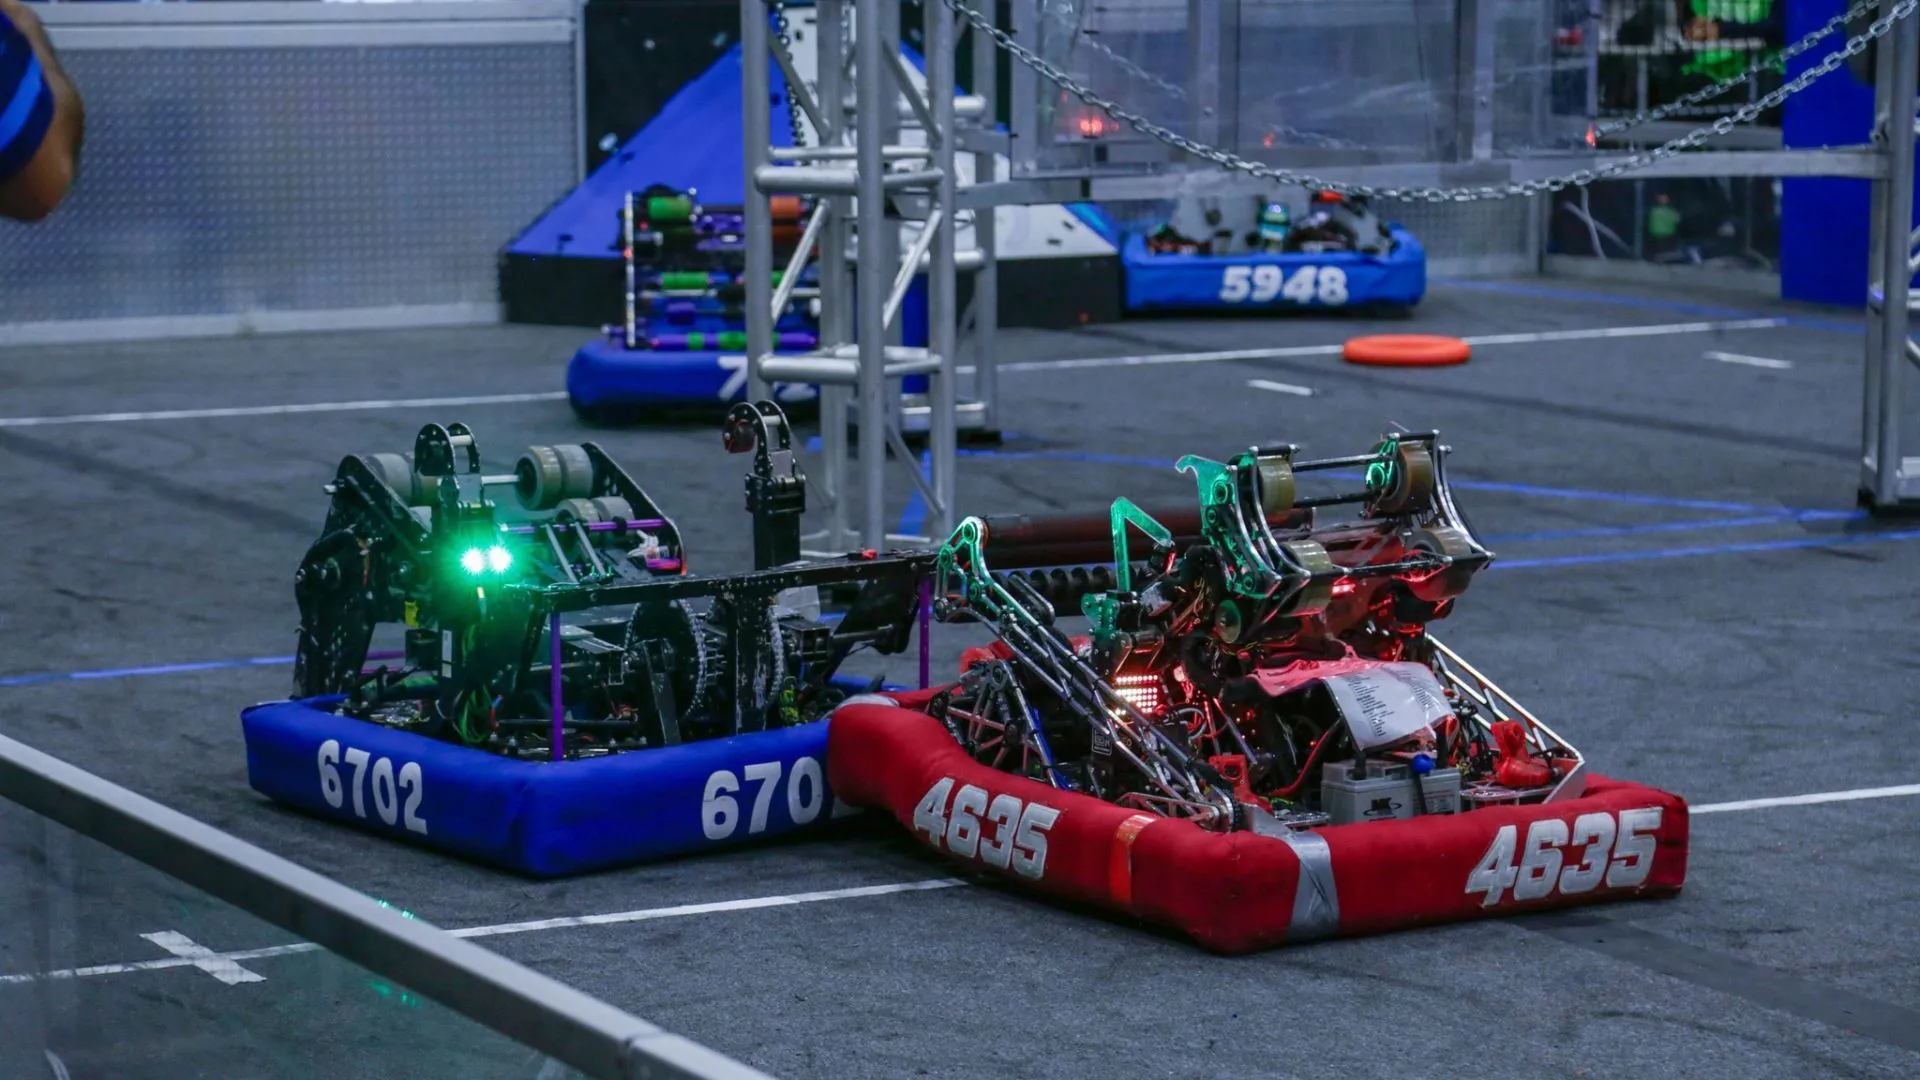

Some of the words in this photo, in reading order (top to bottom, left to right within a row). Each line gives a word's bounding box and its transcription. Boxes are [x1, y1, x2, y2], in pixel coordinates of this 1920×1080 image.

[1220, 265, 1348, 305] 5948
[318, 739, 428, 835] 6702
[702, 756, 866, 840] 670
[913, 777, 1060, 878] 4635
[1465, 807, 1663, 908] 4635
